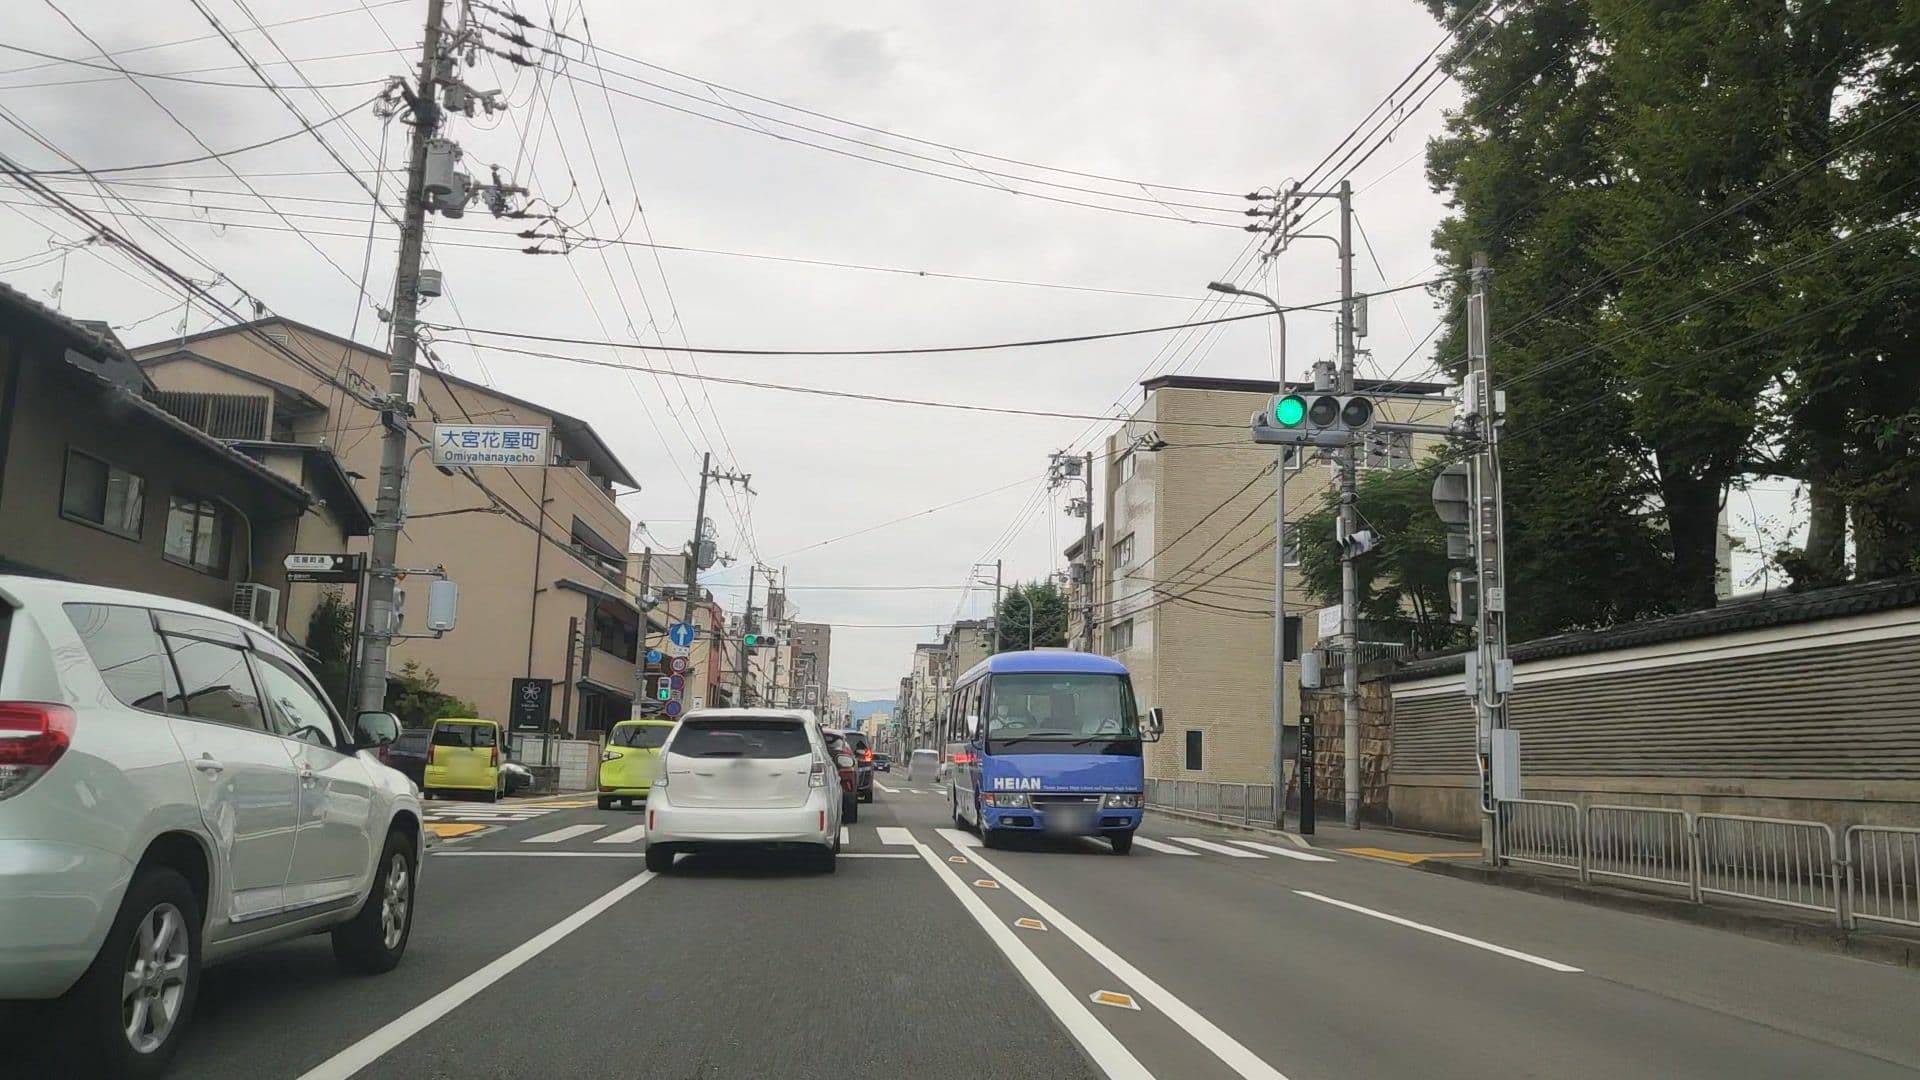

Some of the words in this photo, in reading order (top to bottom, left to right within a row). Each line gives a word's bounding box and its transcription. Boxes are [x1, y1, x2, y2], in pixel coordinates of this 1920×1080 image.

[441, 431, 540, 449] 大宮花屋町
[445, 451, 535, 463] Omiyahanayacho
[994, 777, 1041, 790] HEIAN
